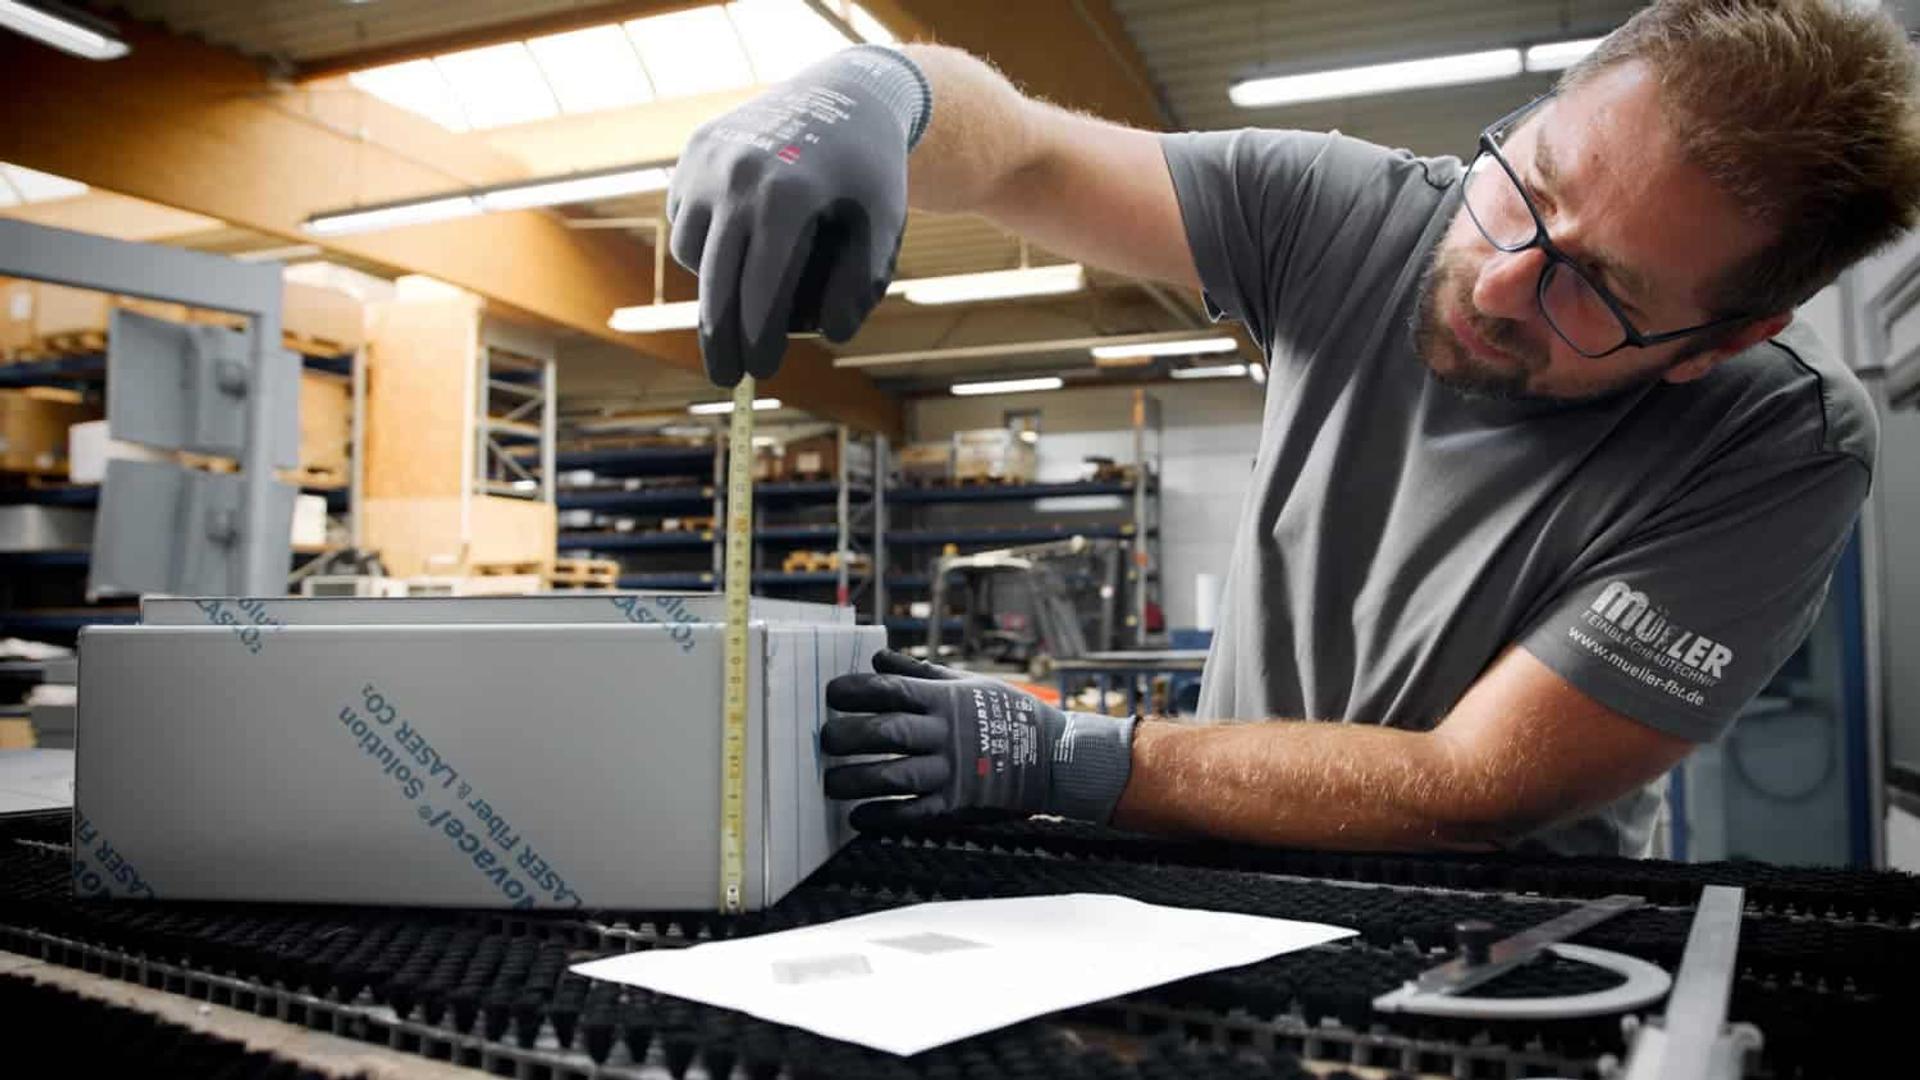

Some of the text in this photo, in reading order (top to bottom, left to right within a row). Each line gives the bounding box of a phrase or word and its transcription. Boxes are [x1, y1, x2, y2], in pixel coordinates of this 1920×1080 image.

[1568, 626, 1705, 706] www.mueller-fbt.de
[339, 706, 424, 800] Solution
[394, 720, 458, 789] LASER
[467, 798, 521, 851] Fiber
[516, 844, 582, 909] LASER
